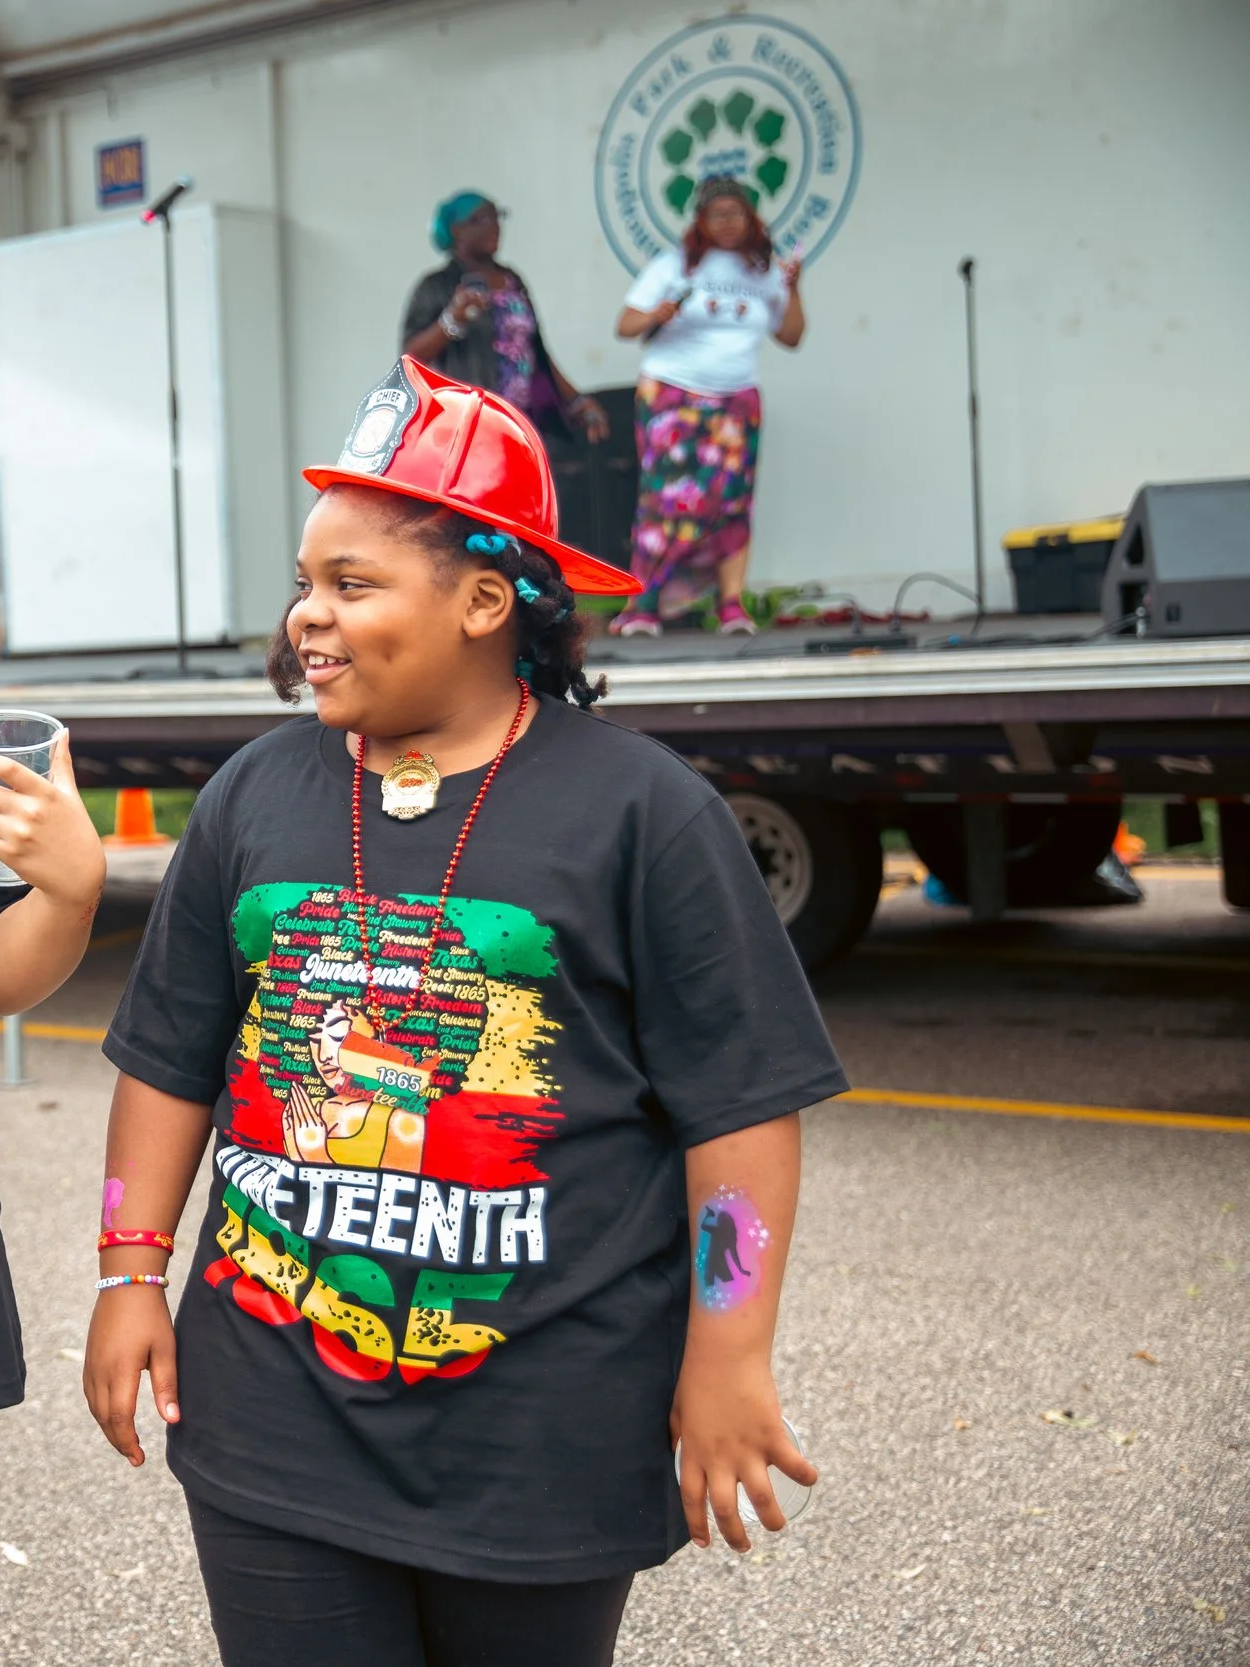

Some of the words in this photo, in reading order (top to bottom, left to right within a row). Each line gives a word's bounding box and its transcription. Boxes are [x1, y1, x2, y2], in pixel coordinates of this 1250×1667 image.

[376, 391, 401, 403] CHIEF
[312, 892, 334, 903] 1865
[300, 901, 340, 918] Pride
[379, 900, 438, 916] Freedom
[275, 914, 334, 932] Celebrate
[272, 931, 290, 944] ree
[291, 933, 320, 946] Pride
[320, 935, 342, 946] 1865
[341, 936, 380, 952] Prde
[379, 930, 430, 946] Freedom
[321, 947, 355, 962] Black
[431, 949, 478, 968] Texas
[450, 946, 470, 956] Black
[300, 954, 420, 989] Junetenth
[276, 982, 298, 992] 1865
[310, 980, 326, 991] End
[421, 978, 454, 994] Roots
[455, 985, 486, 1000] 1865
[297, 989, 332, 1002] Freedom
[291, 1000, 323, 1015] Black
[420, 994, 482, 1014] Freedom
[290, 1015, 316, 1028] 1865
[439, 1013, 482, 1028] Celebrate
[279, 1025, 306, 1039] Black
[439, 1034, 477, 1050] Pride
[280, 1056, 312, 1072] Texas
[303, 1075, 320, 1084] Black
[377, 1067, 422, 1092] 1865
[273, 1088, 288, 1098] 1865
[307, 1086, 327, 1096] 1865
[334, 1073, 429, 1115] Juneteenth
